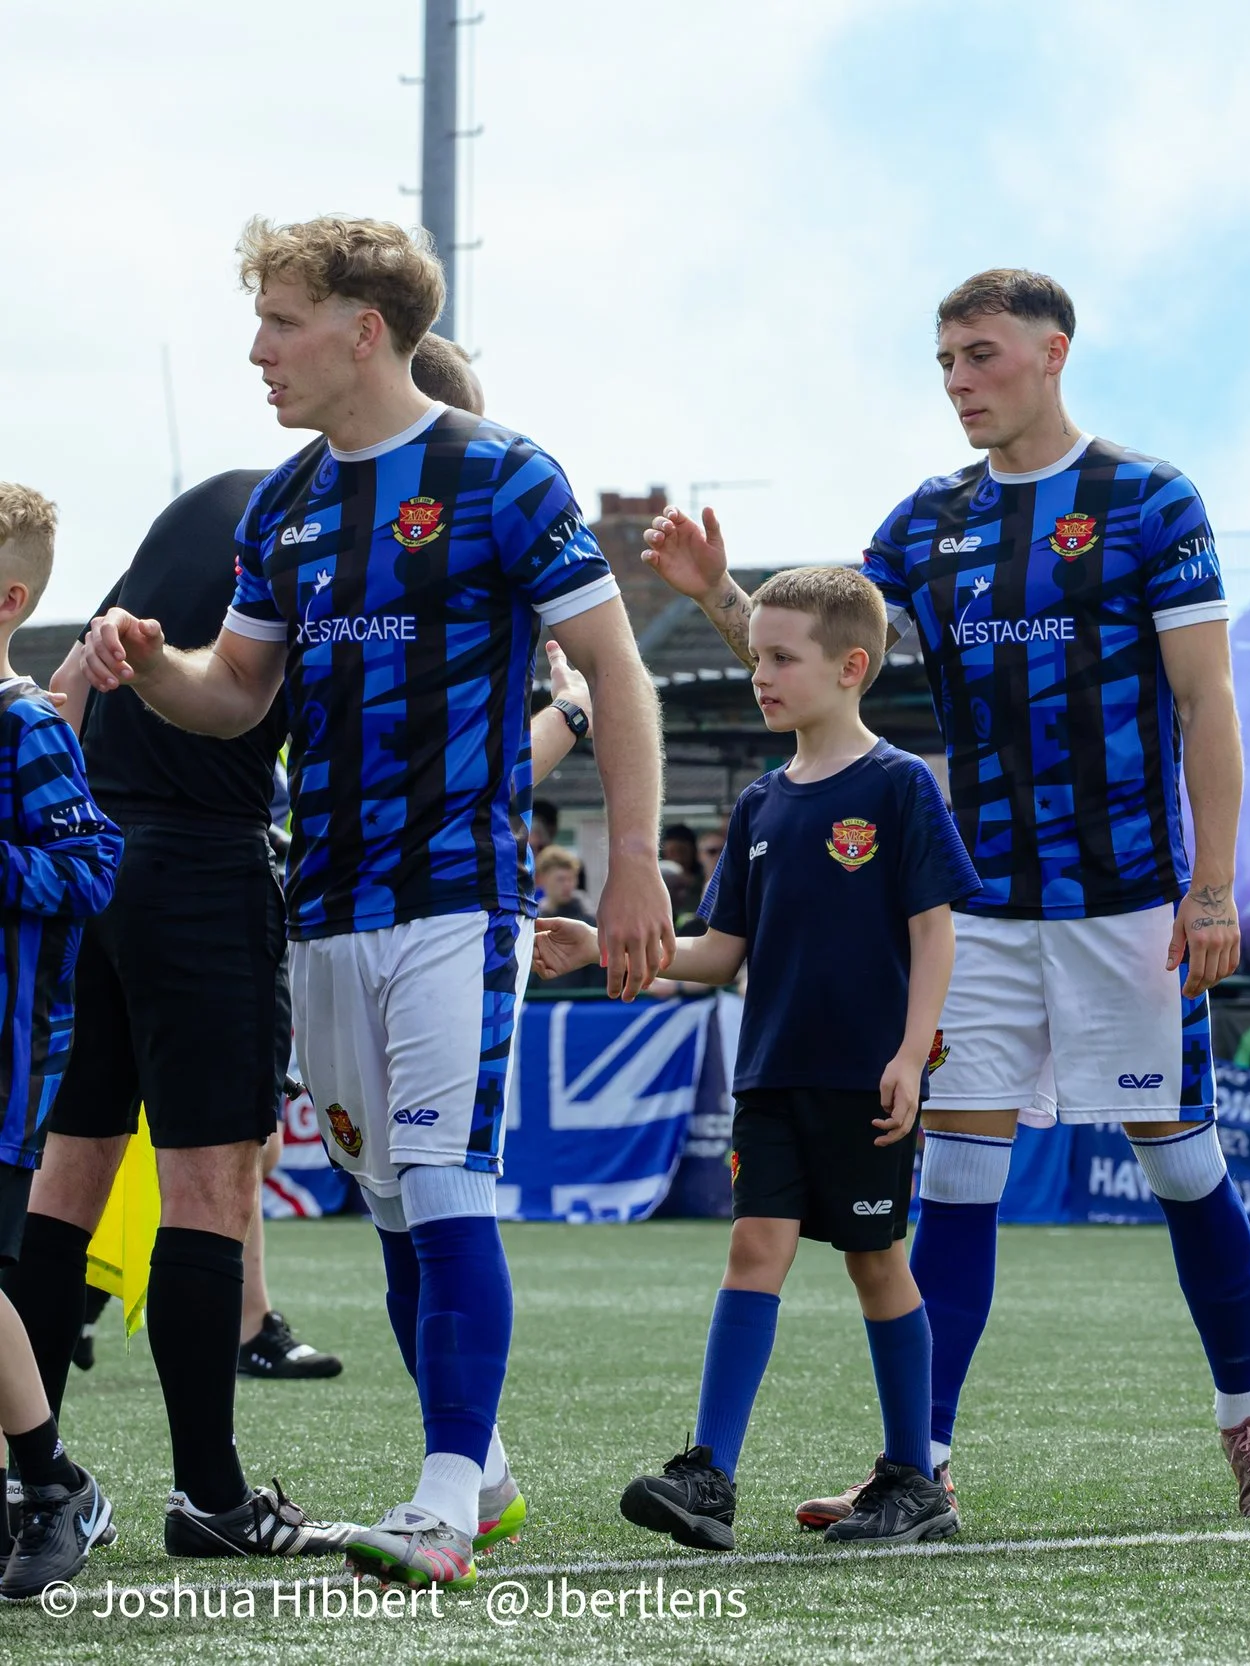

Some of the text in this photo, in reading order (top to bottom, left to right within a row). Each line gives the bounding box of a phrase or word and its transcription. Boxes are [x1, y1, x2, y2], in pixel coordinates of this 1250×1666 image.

[281, 522, 321, 546] EV2
[938, 535, 983, 554] EV2
[949, 609, 1075, 646] VESTACARE
[1118, 1073, 1164, 1089] EV2
[852, 1199, 893, 1216] EV2
